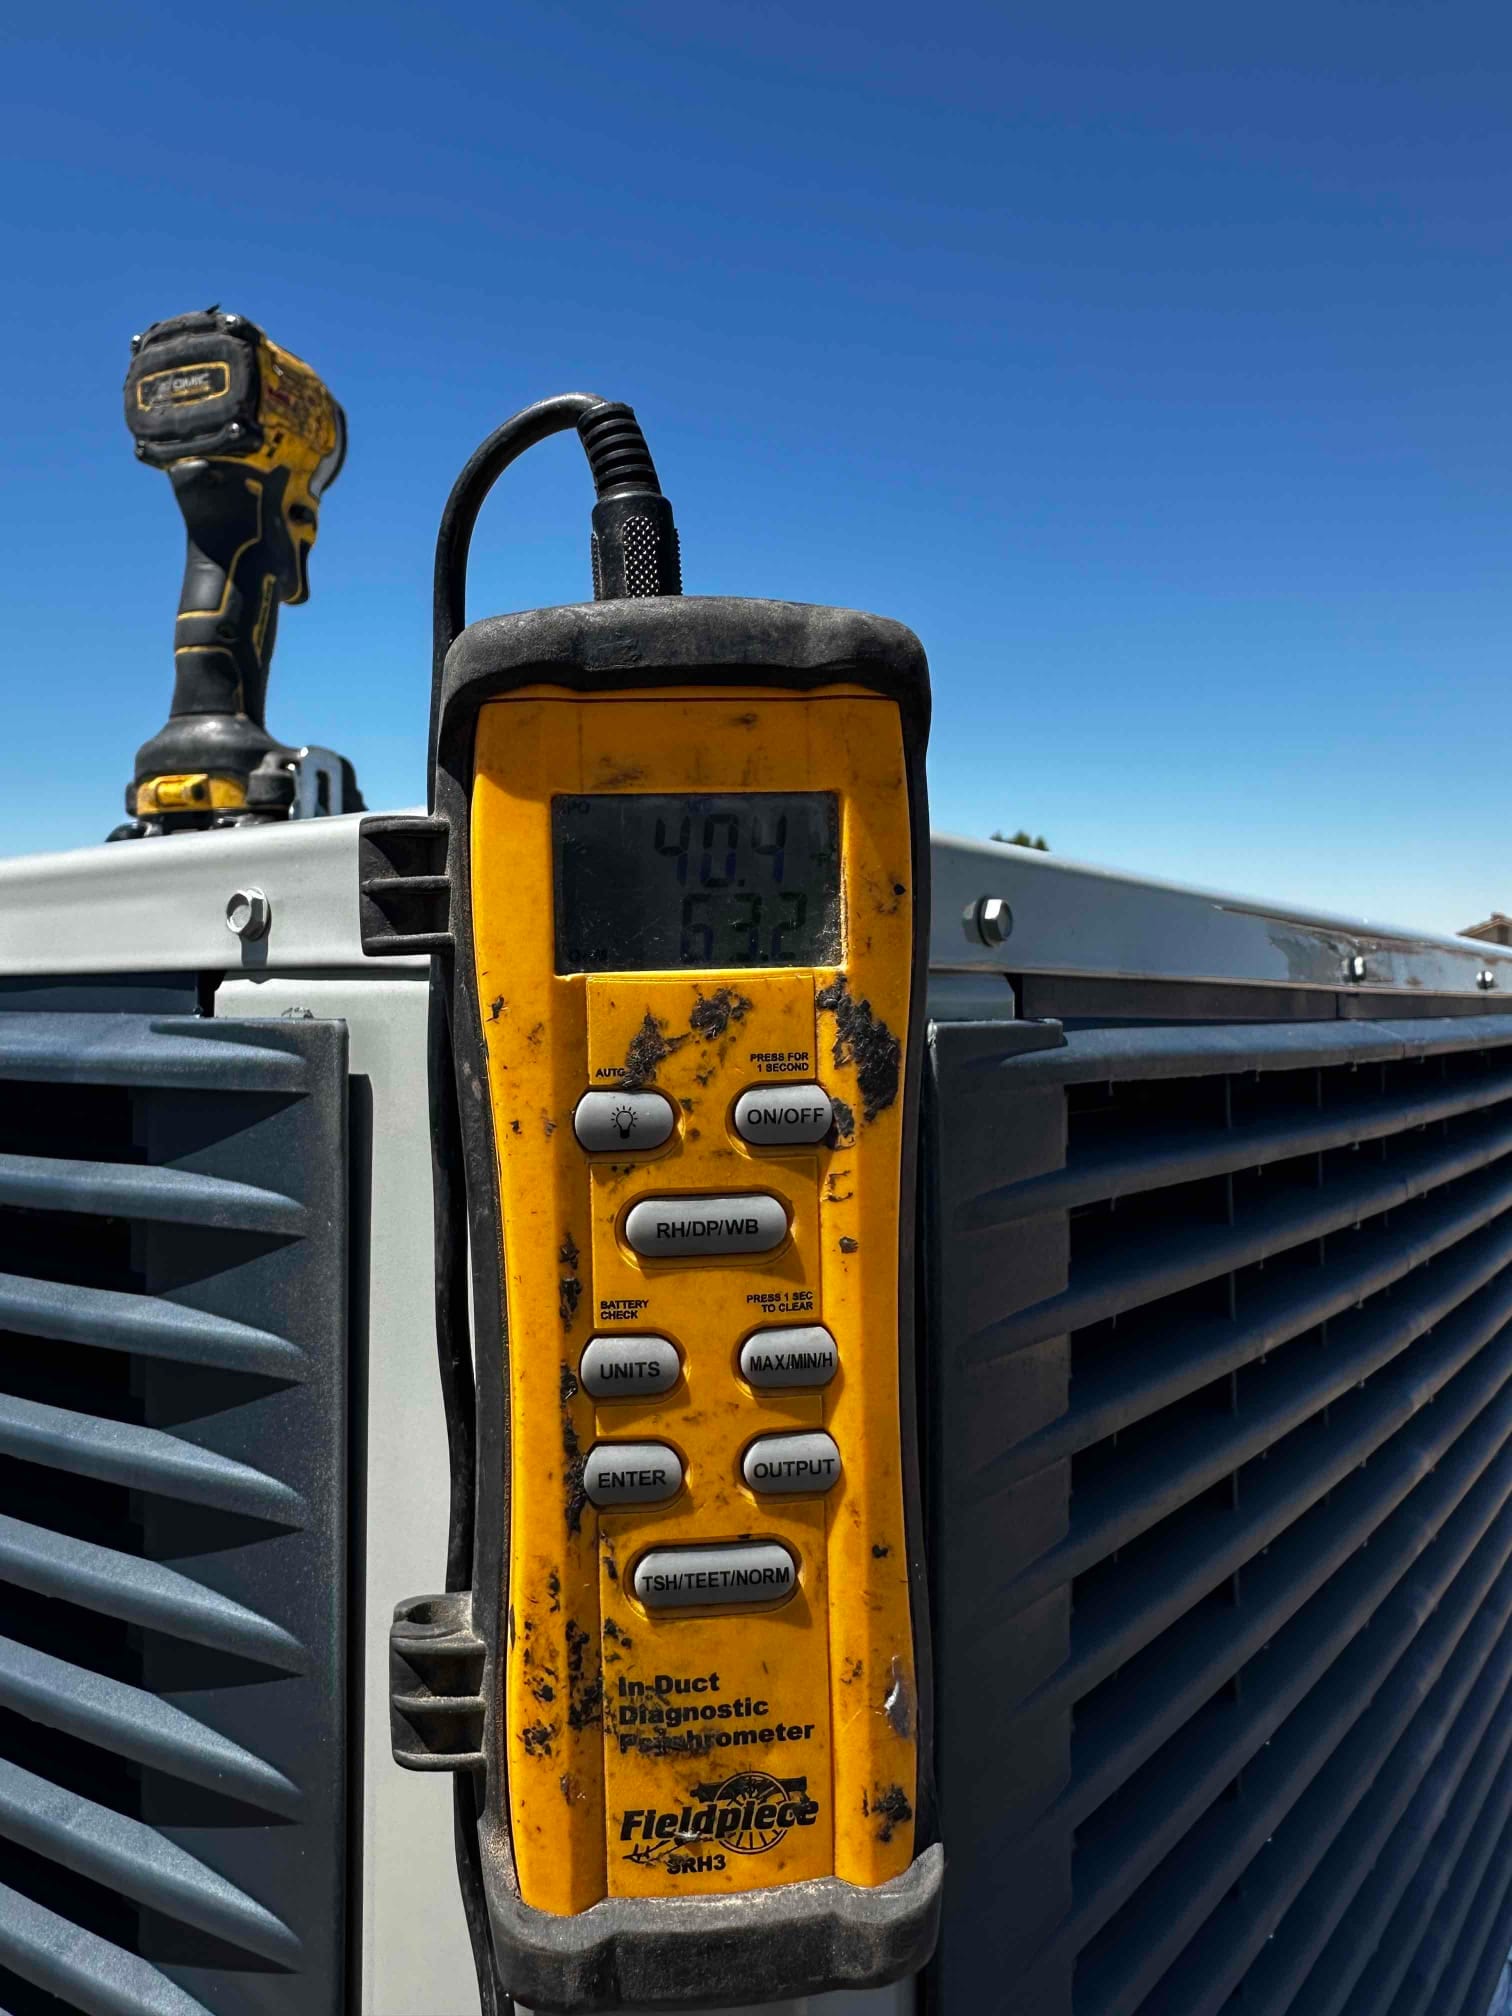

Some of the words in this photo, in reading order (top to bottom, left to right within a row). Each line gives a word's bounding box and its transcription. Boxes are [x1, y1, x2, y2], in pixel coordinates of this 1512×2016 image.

[750, 1053, 784, 1062] PRESS
[787, 1052, 808, 1061] FOR
[757, 1064, 762, 1072] 1
[766, 1063, 809, 1072] SECOND
[747, 1108, 824, 1125] ON/OFF
[656, 1218, 759, 1238] RH/DP/WB
[600, 1300, 649, 1310] BATTERY
[746, 1293, 781, 1304] PRESS
[792, 1291, 813, 1301] SEC
[761, 1304, 776, 1312] TO
[778, 1302, 813, 1312] CLEAR
[600, 1310, 639, 1320] CHECK
[600, 1361, 661, 1380] UNITS
[750, 1352, 833, 1371] MAX/MIN/H
[753, 1459, 835, 1478] OUTPUT
[598, 1469, 667, 1488] ENTER
[642, 1567, 790, 1592] TSH/TEET/NORM
[618, 1672, 720, 1697] In-Duct
[618, 1697, 769, 1727] Diagnostic
[620, 1800, 820, 1842] Fieldpiece
